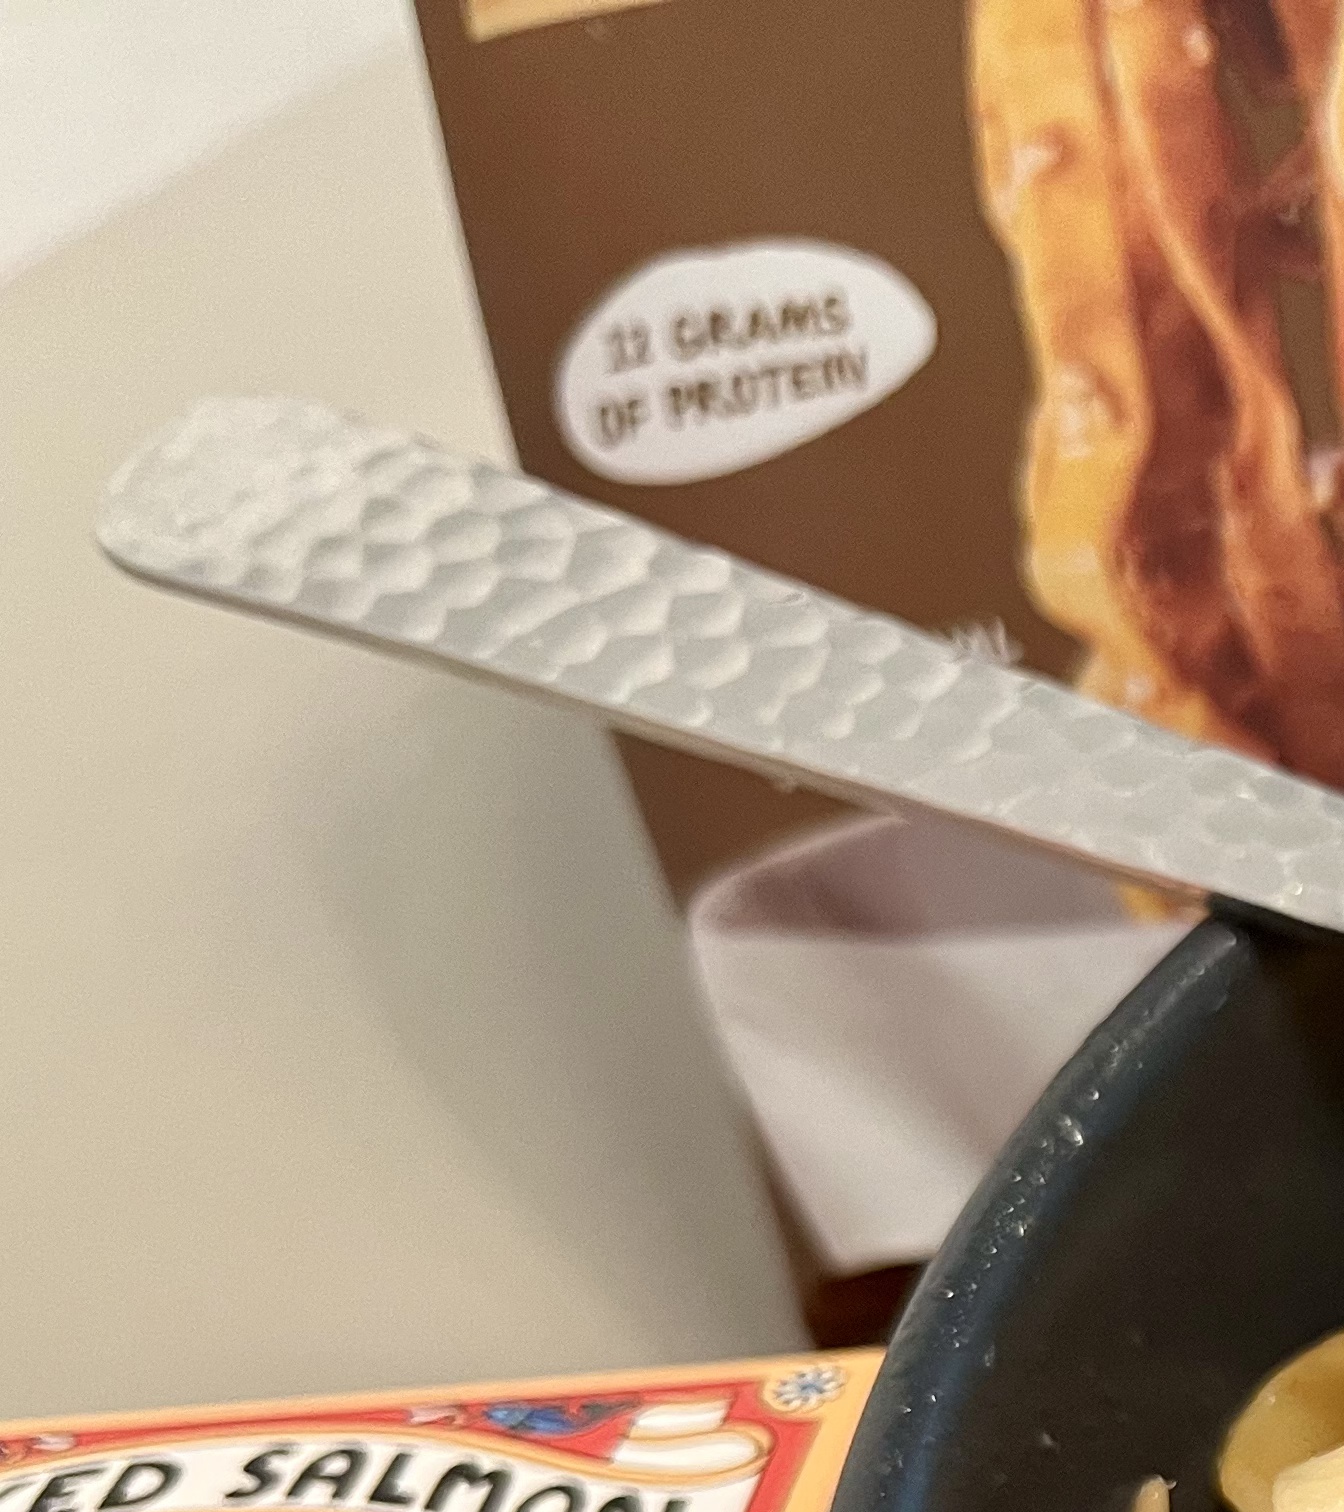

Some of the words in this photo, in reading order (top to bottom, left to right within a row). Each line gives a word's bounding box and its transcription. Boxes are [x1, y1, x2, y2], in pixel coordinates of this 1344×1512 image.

[672, 292, 852, 362] GRAMS
[596, 385, 648, 448] OF
[668, 345, 868, 430] PROTEIN
